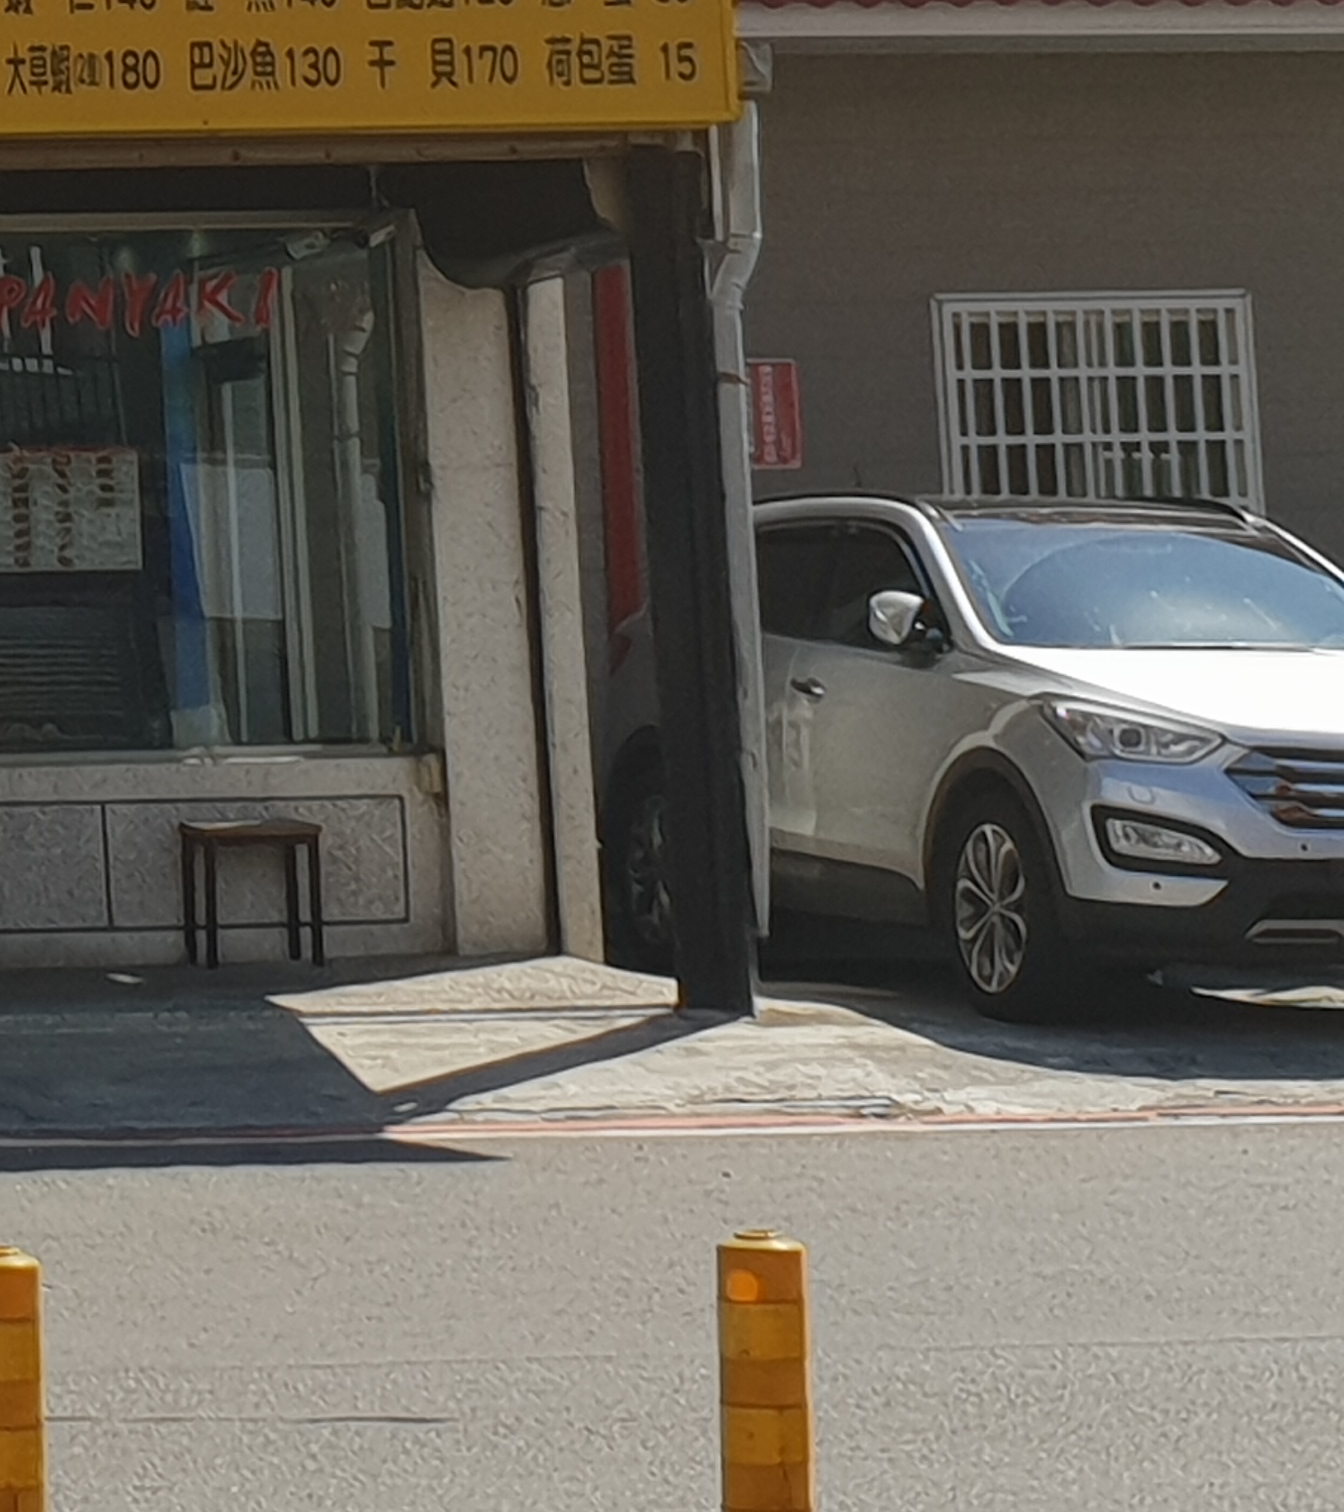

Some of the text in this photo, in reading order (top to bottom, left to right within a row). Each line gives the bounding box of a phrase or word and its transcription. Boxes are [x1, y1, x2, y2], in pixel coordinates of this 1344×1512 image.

[104, 49, 161, 91] 180
[189, 38, 280, 92] 巴沙魚
[285, 46, 341, 88] 130
[462, 44, 519, 85] 170
[544, 33, 637, 87] 荷包蛋
[660, 41, 697, 82] 15
